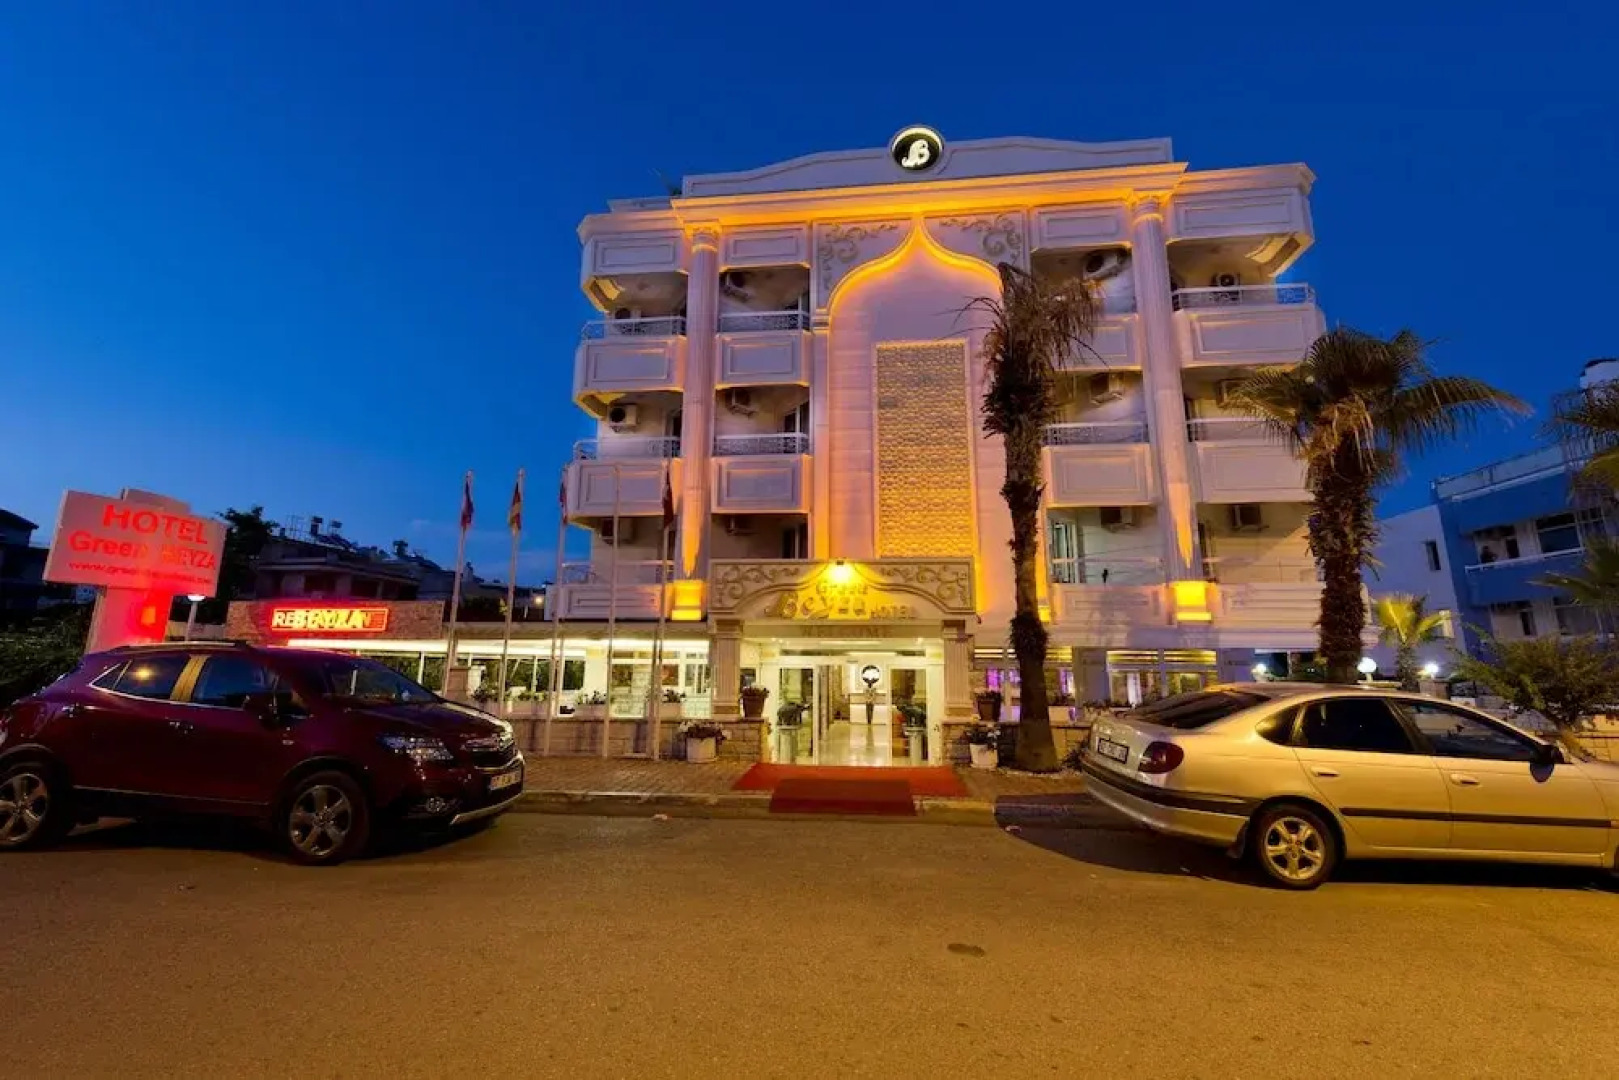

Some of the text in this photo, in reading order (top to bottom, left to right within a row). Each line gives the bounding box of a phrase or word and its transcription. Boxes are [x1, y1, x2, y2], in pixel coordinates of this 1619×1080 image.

[901, 139, 930, 168] B
[102, 504, 208, 545] HOTEL
[67, 530, 149, 559] Green
